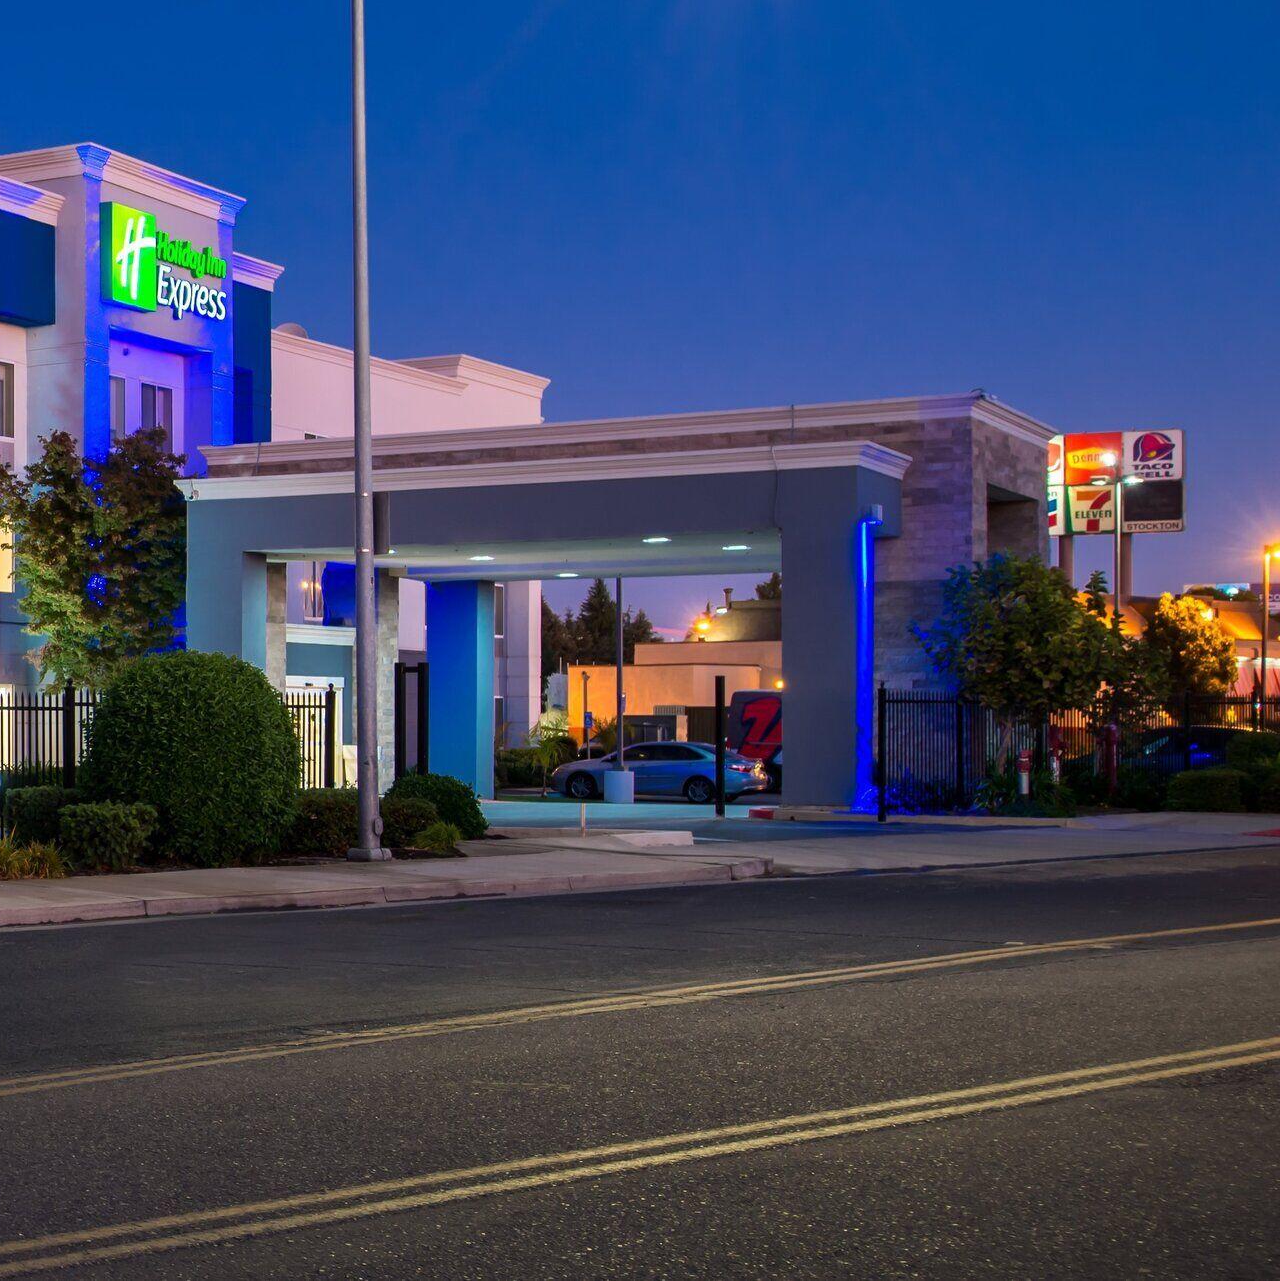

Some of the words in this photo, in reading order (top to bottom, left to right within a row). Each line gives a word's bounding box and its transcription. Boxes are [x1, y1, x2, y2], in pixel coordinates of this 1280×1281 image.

[156, 230, 206, 279] Holiday
[204, 246, 227, 279] Inn
[156, 264, 227, 320] Express
[1131, 463, 1174, 471] TACO
[1076, 489, 1112, 532] 7
[1126, 522, 1180, 531] STOCKTON
